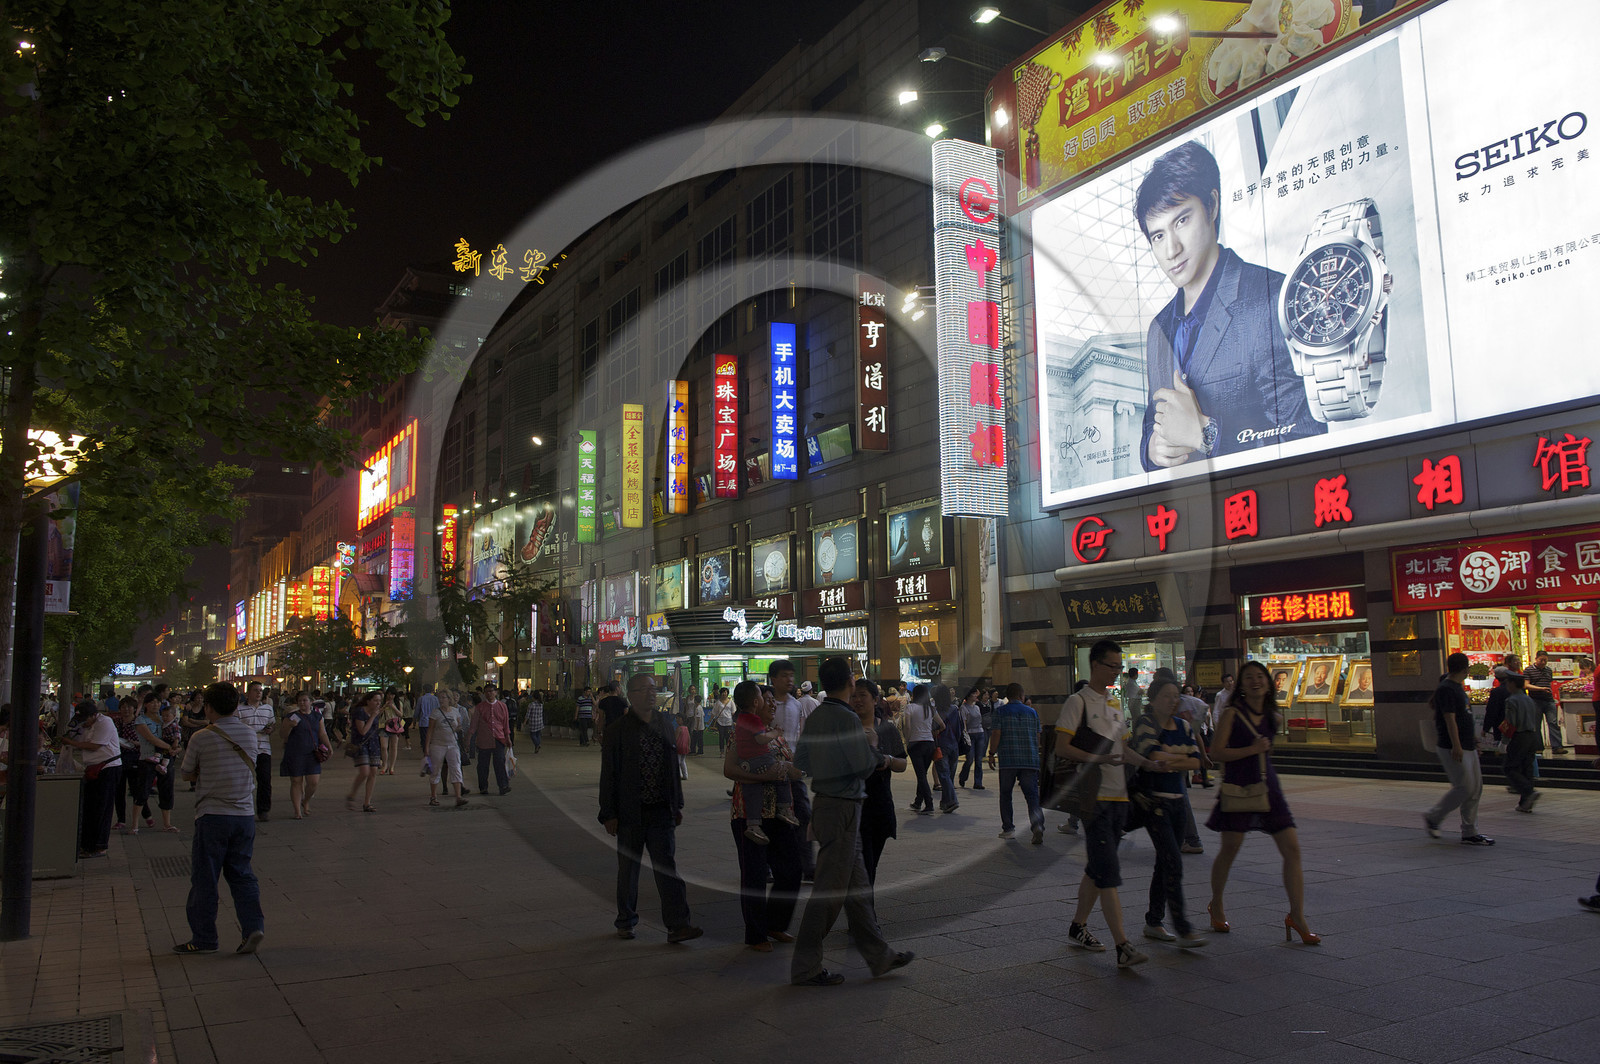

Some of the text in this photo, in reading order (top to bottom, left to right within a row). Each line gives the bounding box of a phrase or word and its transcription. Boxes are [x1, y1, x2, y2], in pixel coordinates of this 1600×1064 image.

[1064, 28, 1182, 120] 湾仔码头
[1064, 77, 1187, 161] 好品质 敢承诺
[1454, 111, 1588, 181] SEIKO
[1232, 134, 1370, 202] 超乎寻常的无限创意
[1457, 148, 1590, 204] 致力追求完美
[859, 292, 885, 306] 北京
[1495, 257, 1571, 286] seiko.com.cn
[774, 343, 795, 459] 手机大卖场
[861, 321, 886, 433] 亨得利
[715, 381, 737, 472] 珠宝广场
[1236, 423, 1296, 444] Premier
[579, 458, 595, 518] 天福茗茶
[625, 425, 641, 520] 全聚德烤鸭店
[716, 479, 737, 490] 三层
[818, 587, 845, 607] 亨得利
[895, 574, 927, 596] 亨得利
[1260, 590, 1355, 623] 维修相机
[1508, 579, 1528, 591] YU
[1535, 576, 1561, 588] SHI
